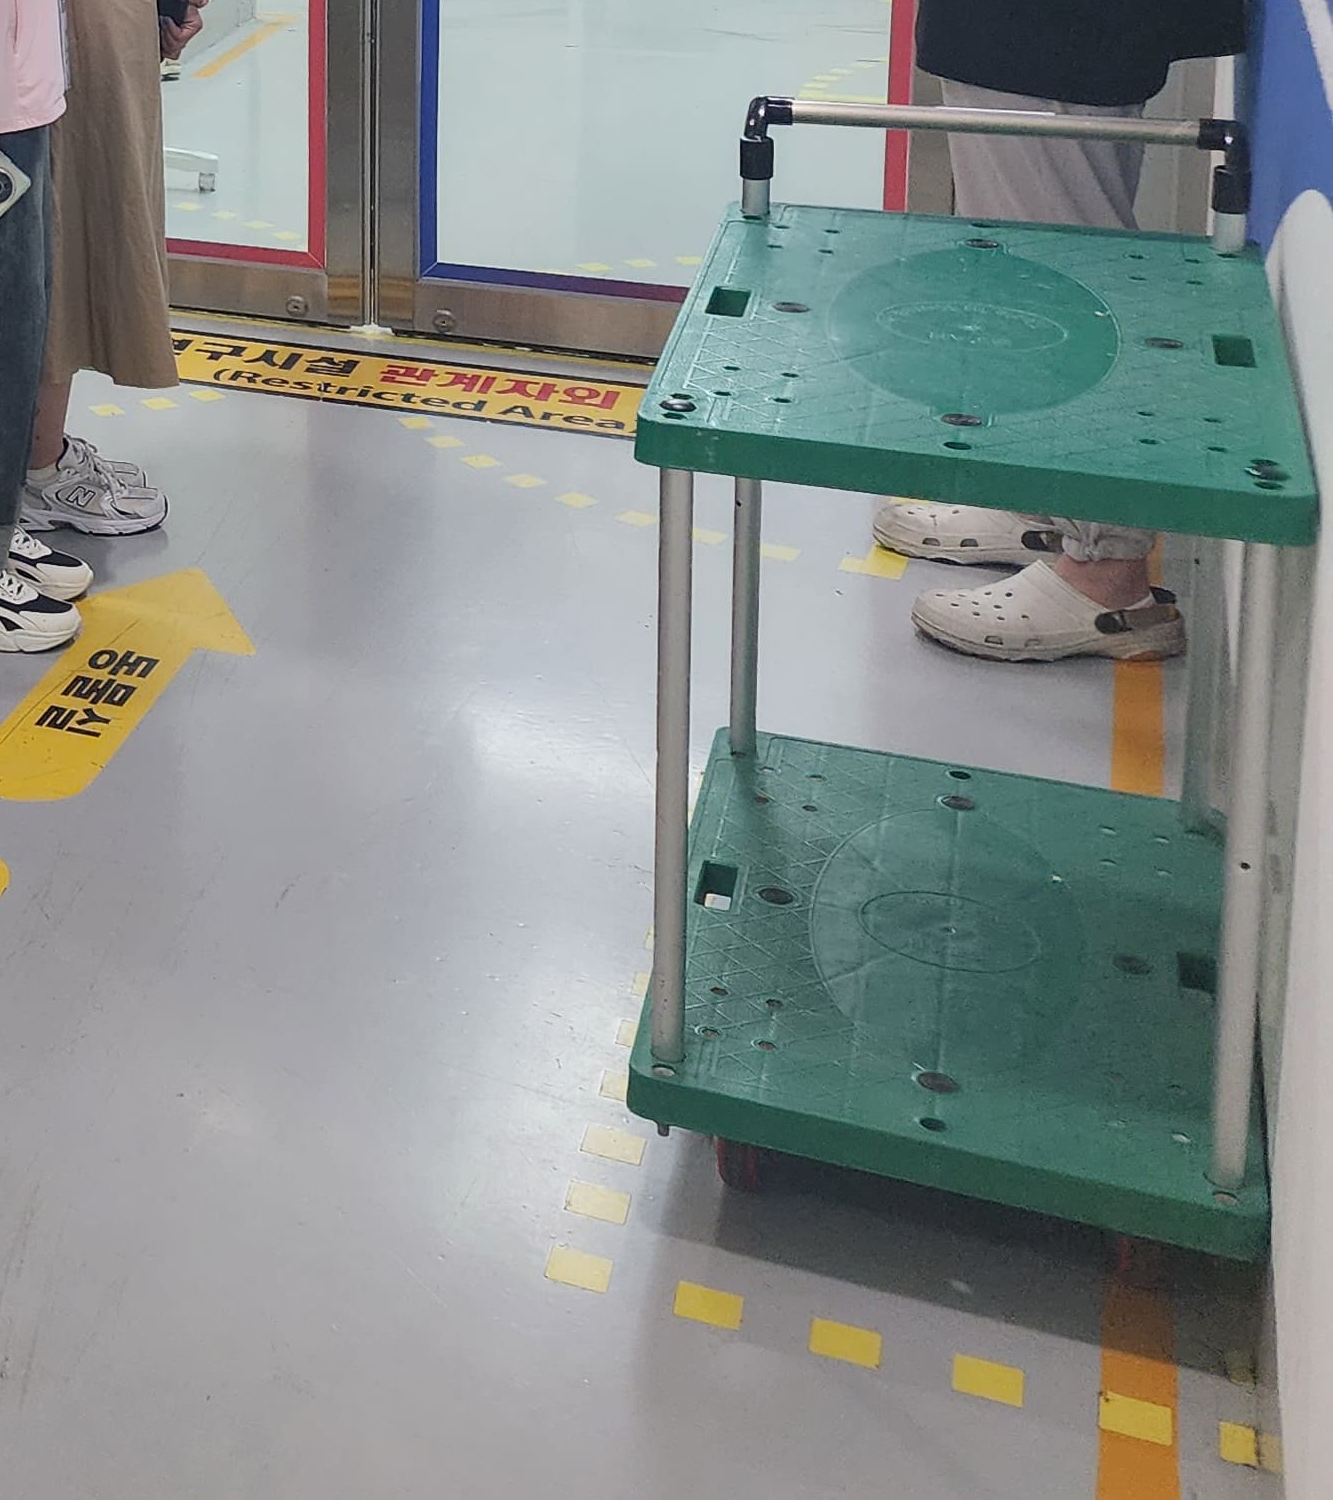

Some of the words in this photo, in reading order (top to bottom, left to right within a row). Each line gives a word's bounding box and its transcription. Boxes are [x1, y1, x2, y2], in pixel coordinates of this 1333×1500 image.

[212, 367, 487, 413] (Restricted
[497, 404, 637, 433] Area
[379, 363, 621, 410] 관계자외
[66, 486, 96, 508] N
